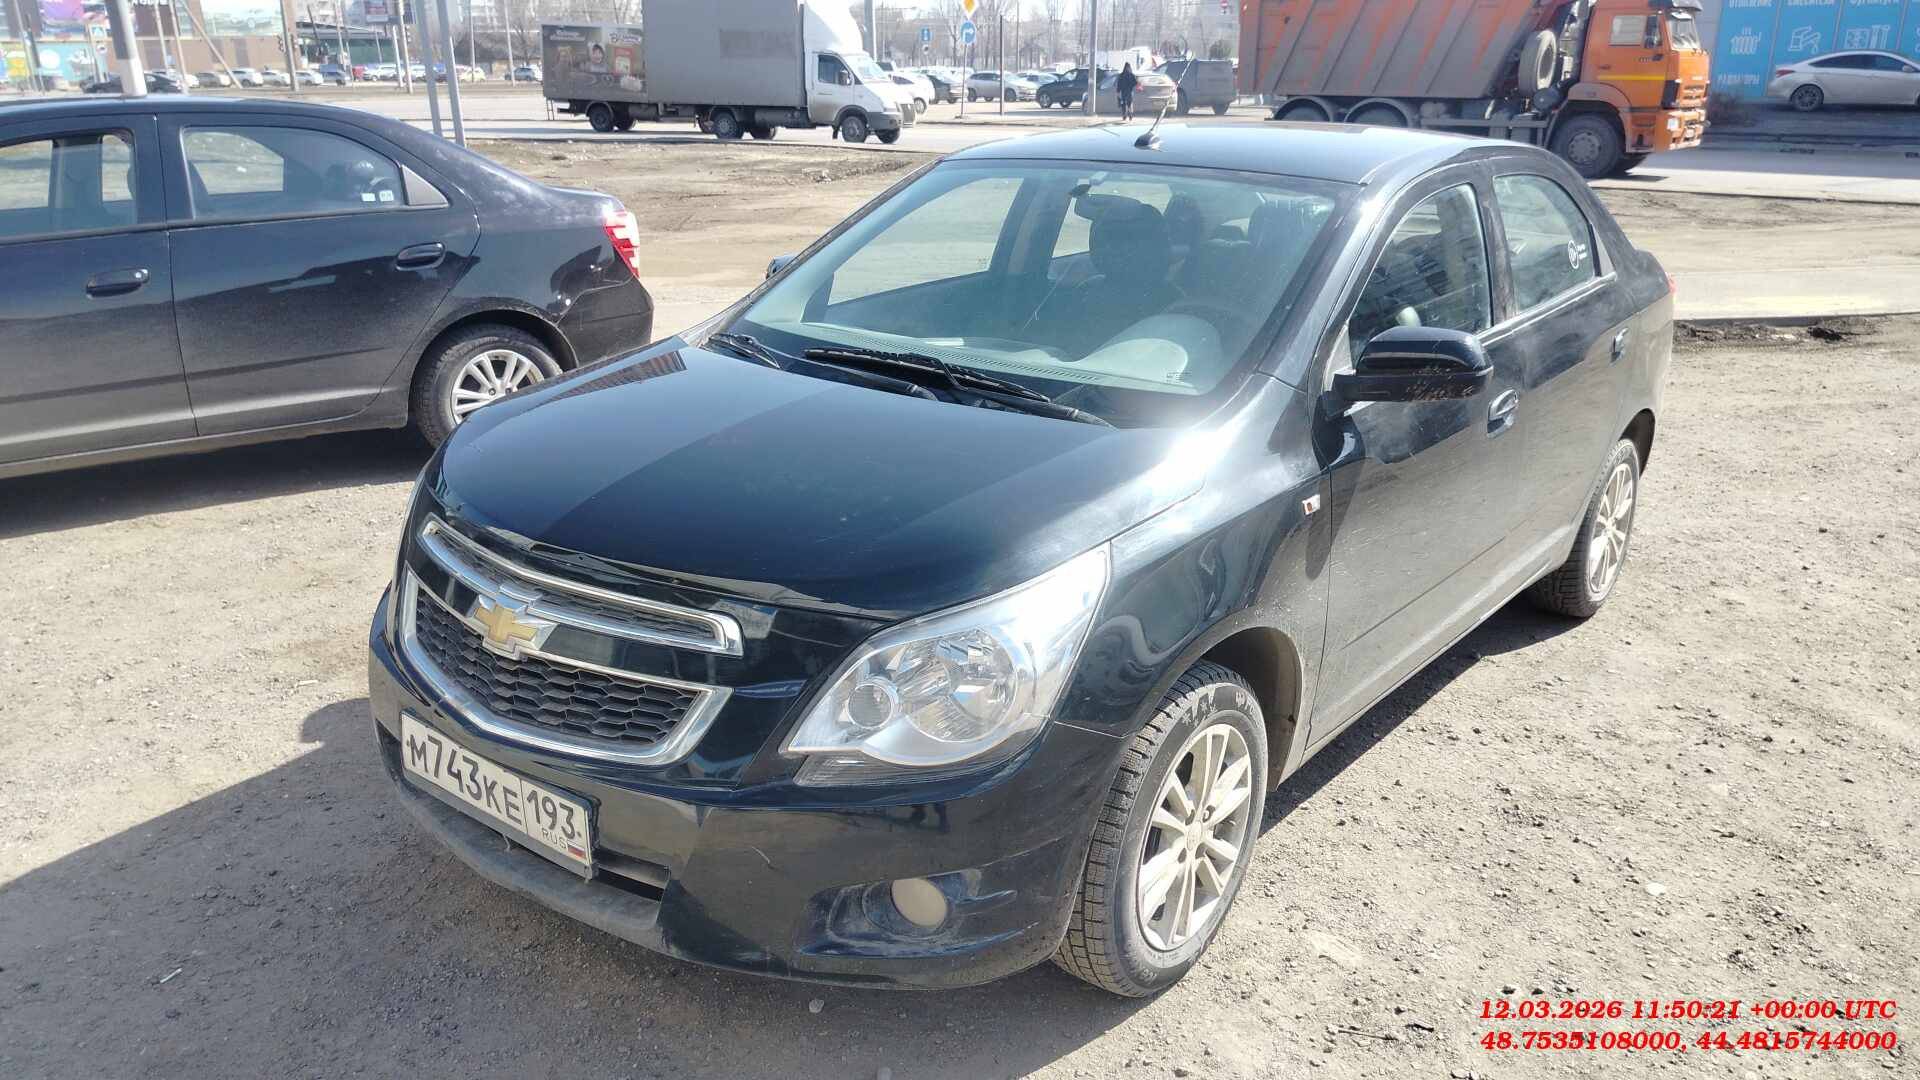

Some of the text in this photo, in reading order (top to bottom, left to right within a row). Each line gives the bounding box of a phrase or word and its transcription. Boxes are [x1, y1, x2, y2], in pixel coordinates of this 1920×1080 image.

[409, 734, 576, 840] М743КЕ 193
[541, 827, 568, 850] RUS
